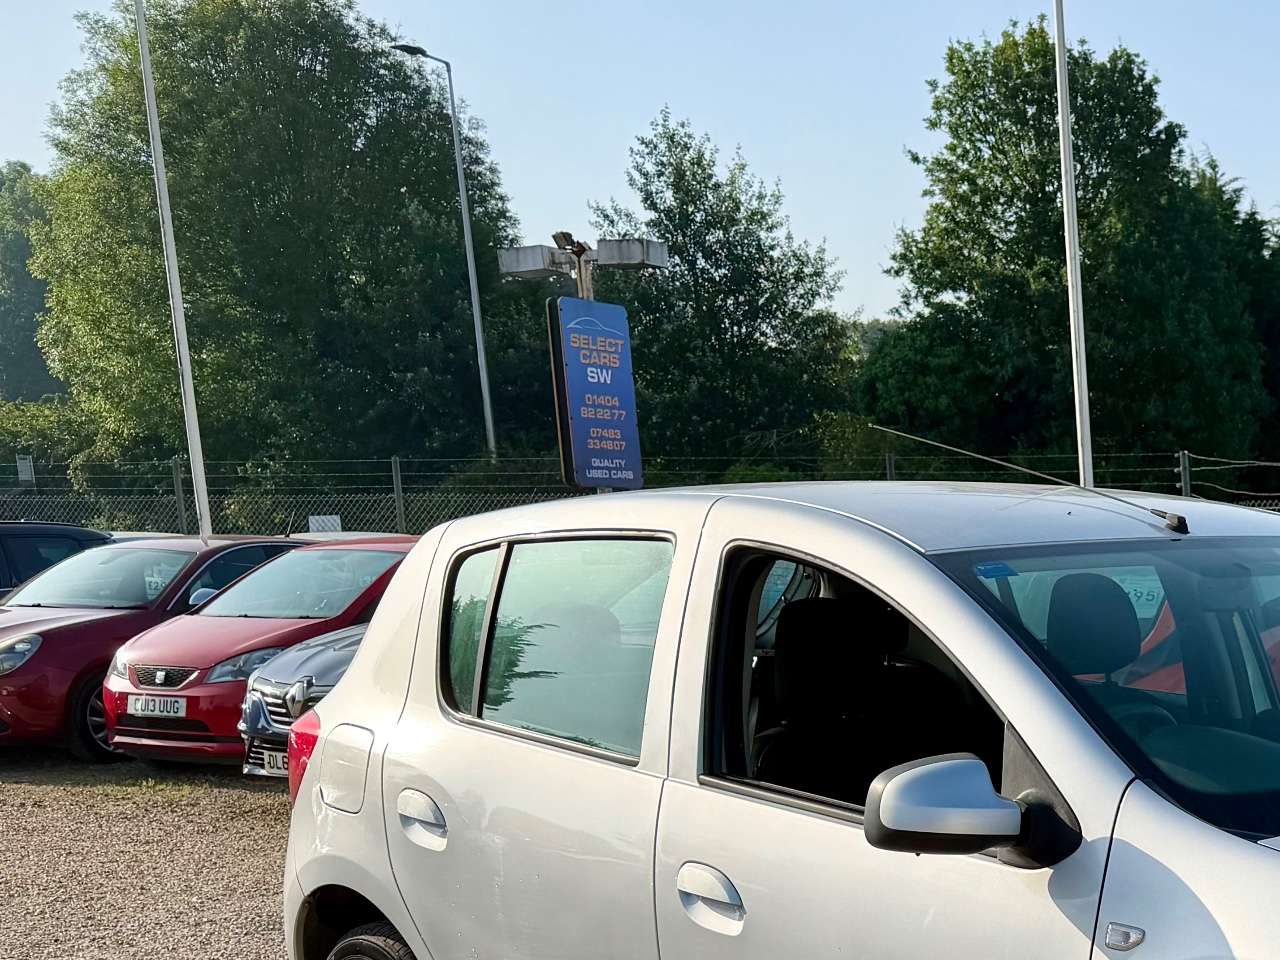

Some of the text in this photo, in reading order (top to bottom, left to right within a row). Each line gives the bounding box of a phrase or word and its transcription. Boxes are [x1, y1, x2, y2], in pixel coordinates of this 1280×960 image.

[570, 333, 625, 352] SELECT
[580, 350, 620, 368] CARS
[587, 367, 612, 384] SW
[585, 394, 619, 407] 01404
[591, 458, 626, 468] QUALITY
[585, 469, 634, 479] USED CARS
[158, 698, 180, 714] UUG
